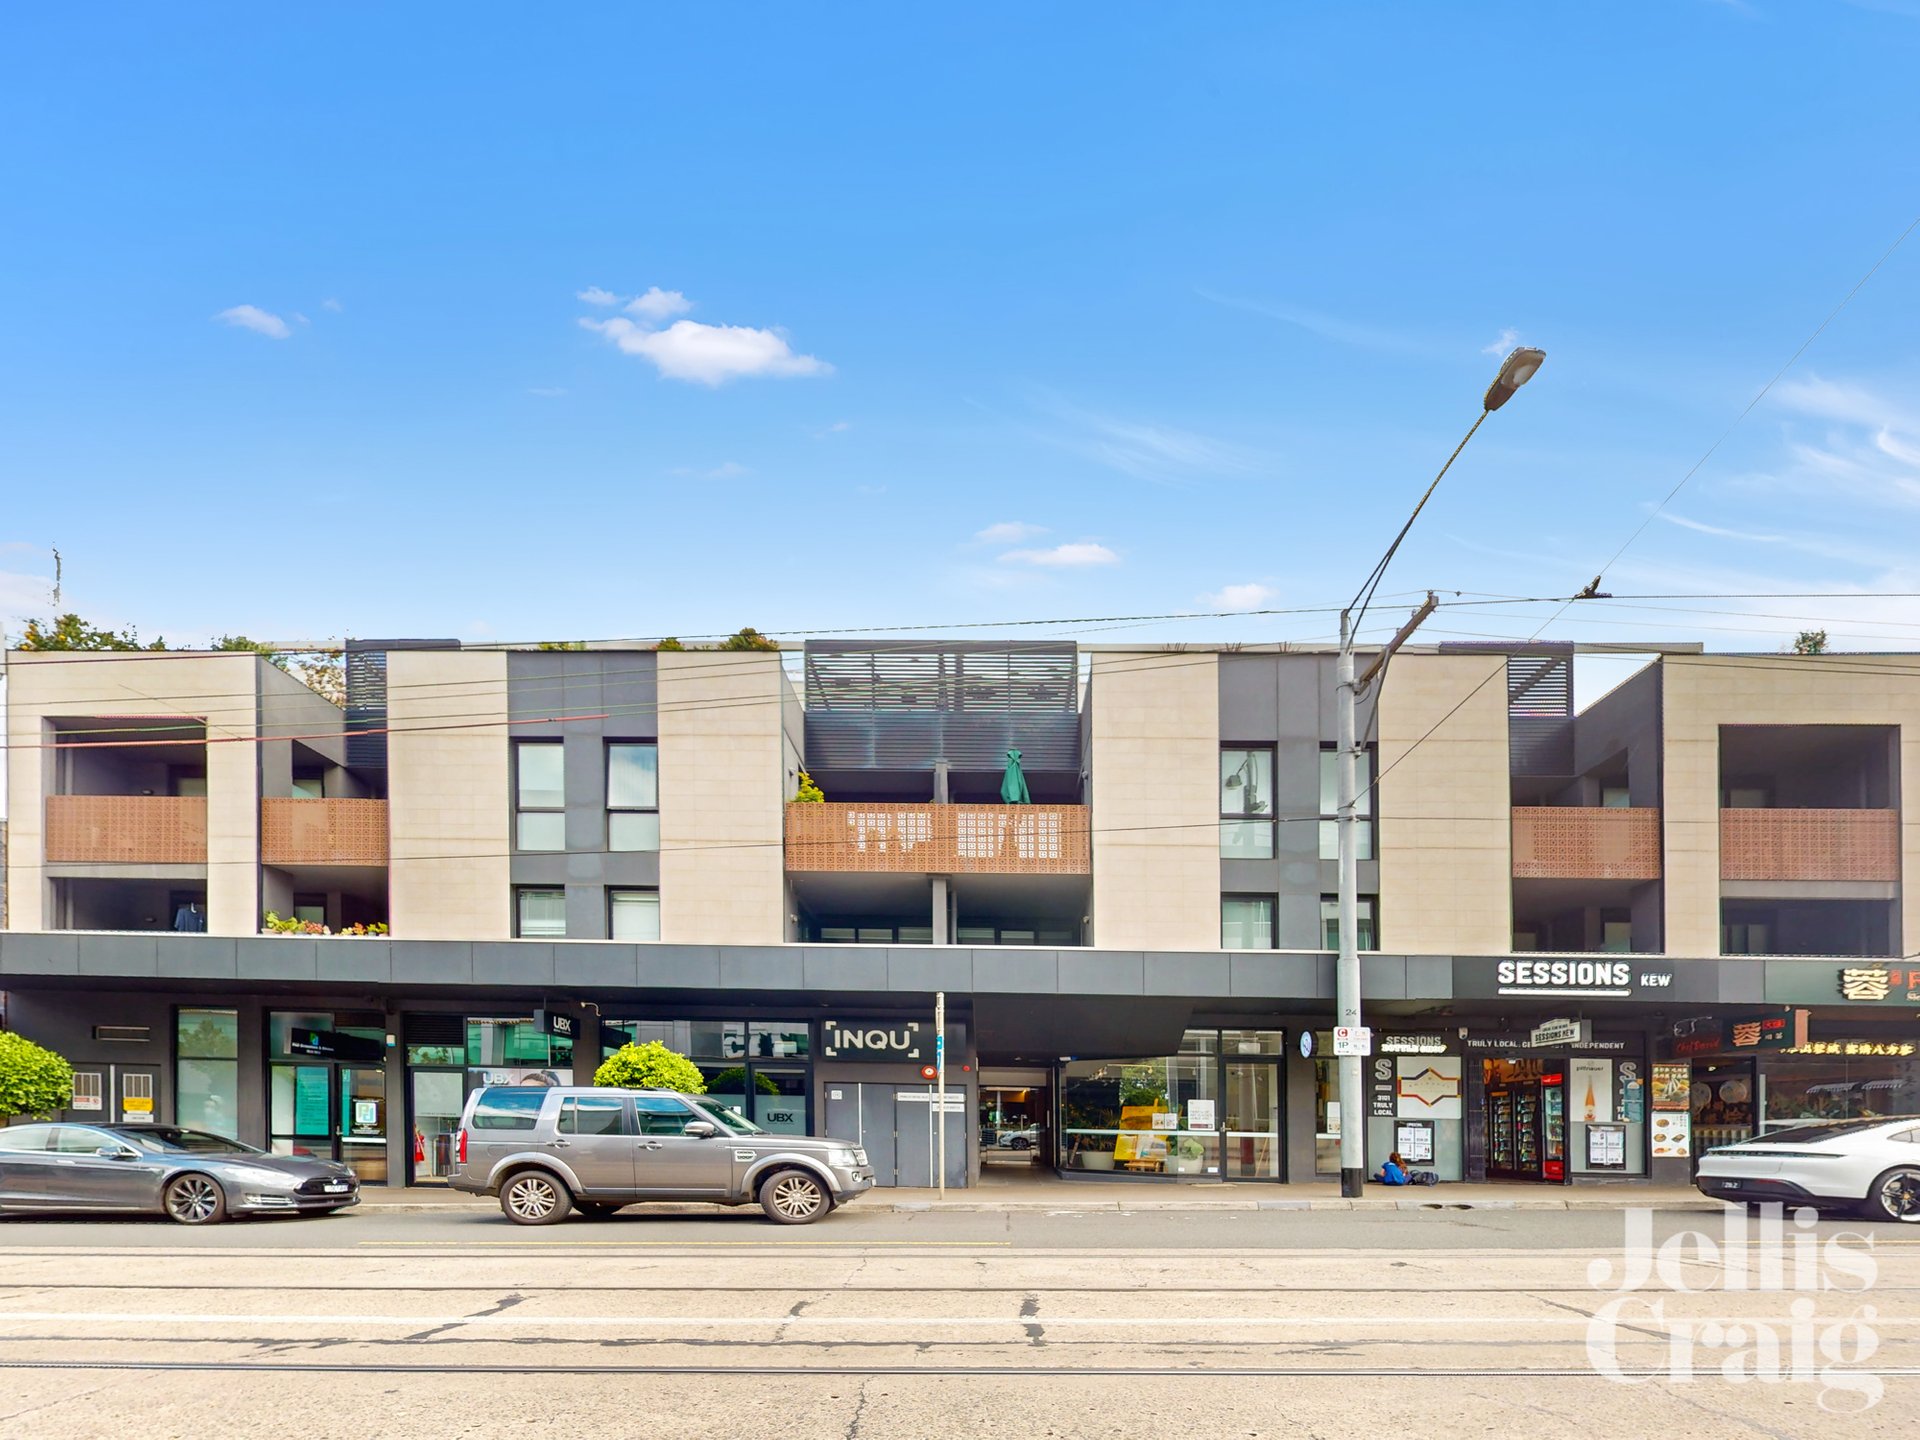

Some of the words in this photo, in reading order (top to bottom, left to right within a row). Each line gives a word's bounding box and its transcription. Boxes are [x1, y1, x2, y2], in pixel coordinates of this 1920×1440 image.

[1498, 960, 1631, 985] SESSIONS
[1640, 973, 1672, 987] KEW
[553, 1016, 571, 1032] UBX
[834, 1029, 910, 1049] INQU
[1386, 1036, 1441, 1045] SESSIONS
[1571, 1041, 1625, 1049] INDEPENDENT
[1375, 1058, 1392, 1080] S
[483, 1072, 515, 1085] UBX
[767, 1113, 794, 1122] UBX
